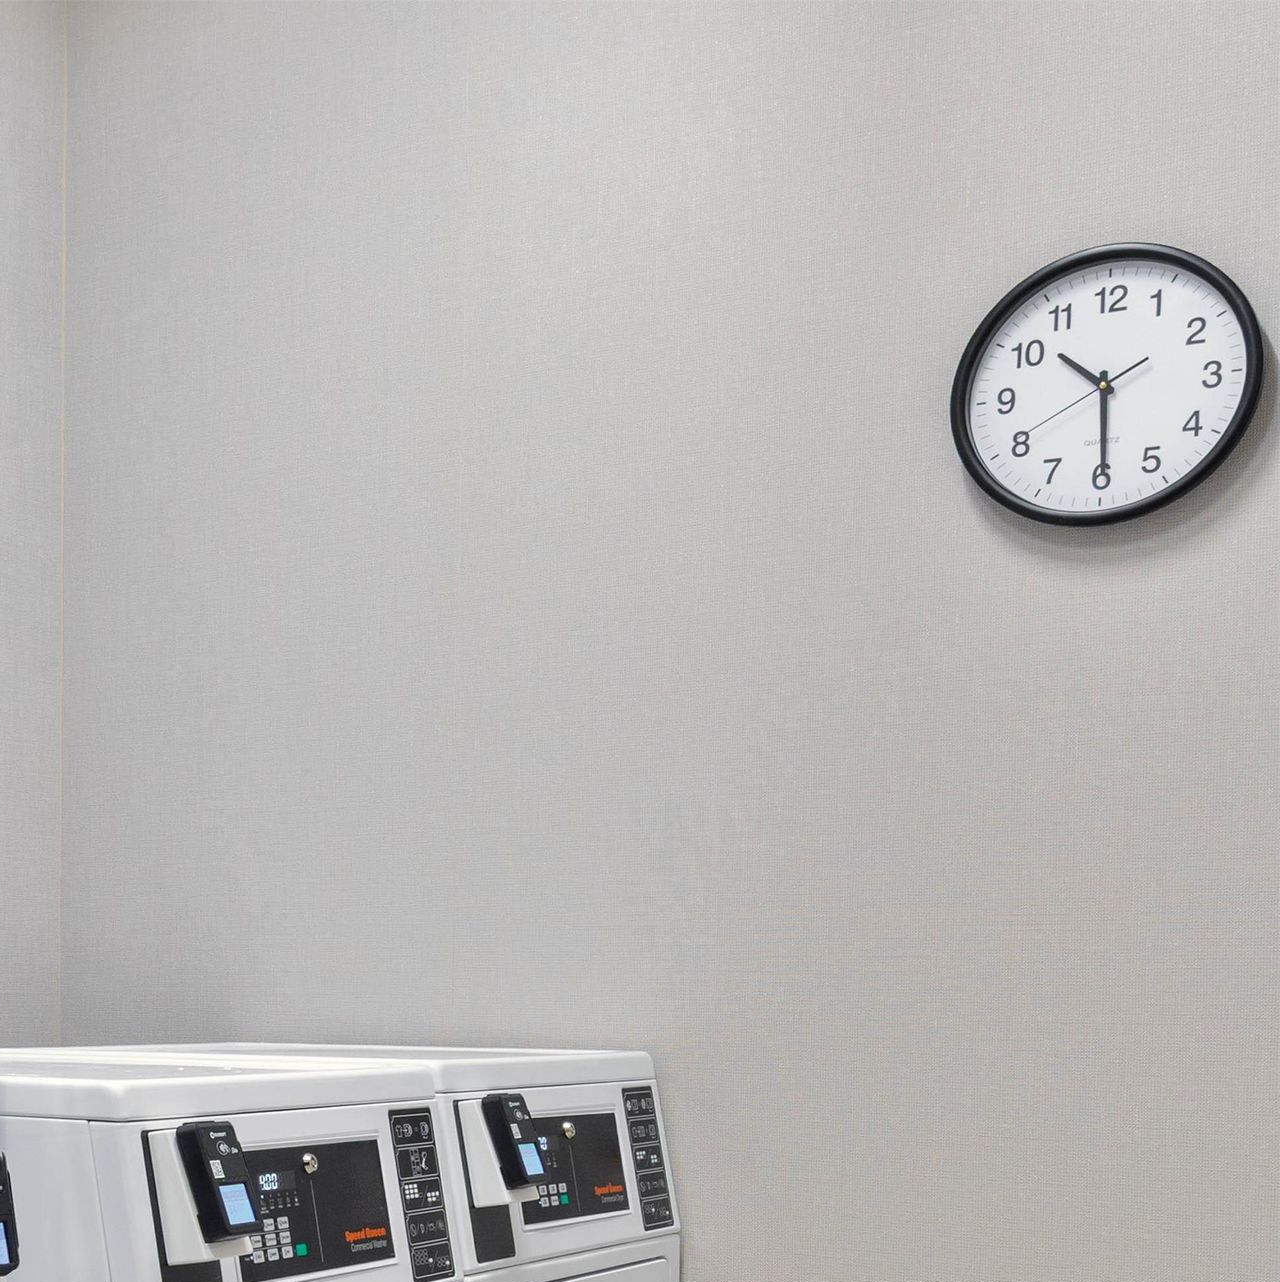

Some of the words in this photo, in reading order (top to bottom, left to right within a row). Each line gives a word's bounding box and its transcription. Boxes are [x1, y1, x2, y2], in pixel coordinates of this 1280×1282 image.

[1094, 285, 1128, 314] 12
[1150, 289, 1162, 317] 1
[1048, 303, 1072, 331] 11
[1185, 317, 1207, 345] 2
[1011, 339, 1044, 369] 10
[1202, 360, 1223, 388] 3
[997, 388, 1016, 415] 9
[1182, 410, 1203, 437] 4
[1011, 431, 1030, 458] 8
[1083, 436, 1120, 446] QUTZ
[1043, 458, 1062, 484] 7
[1141, 446, 1161, 473] 5
[1092, 463, 1111, 490] 6
